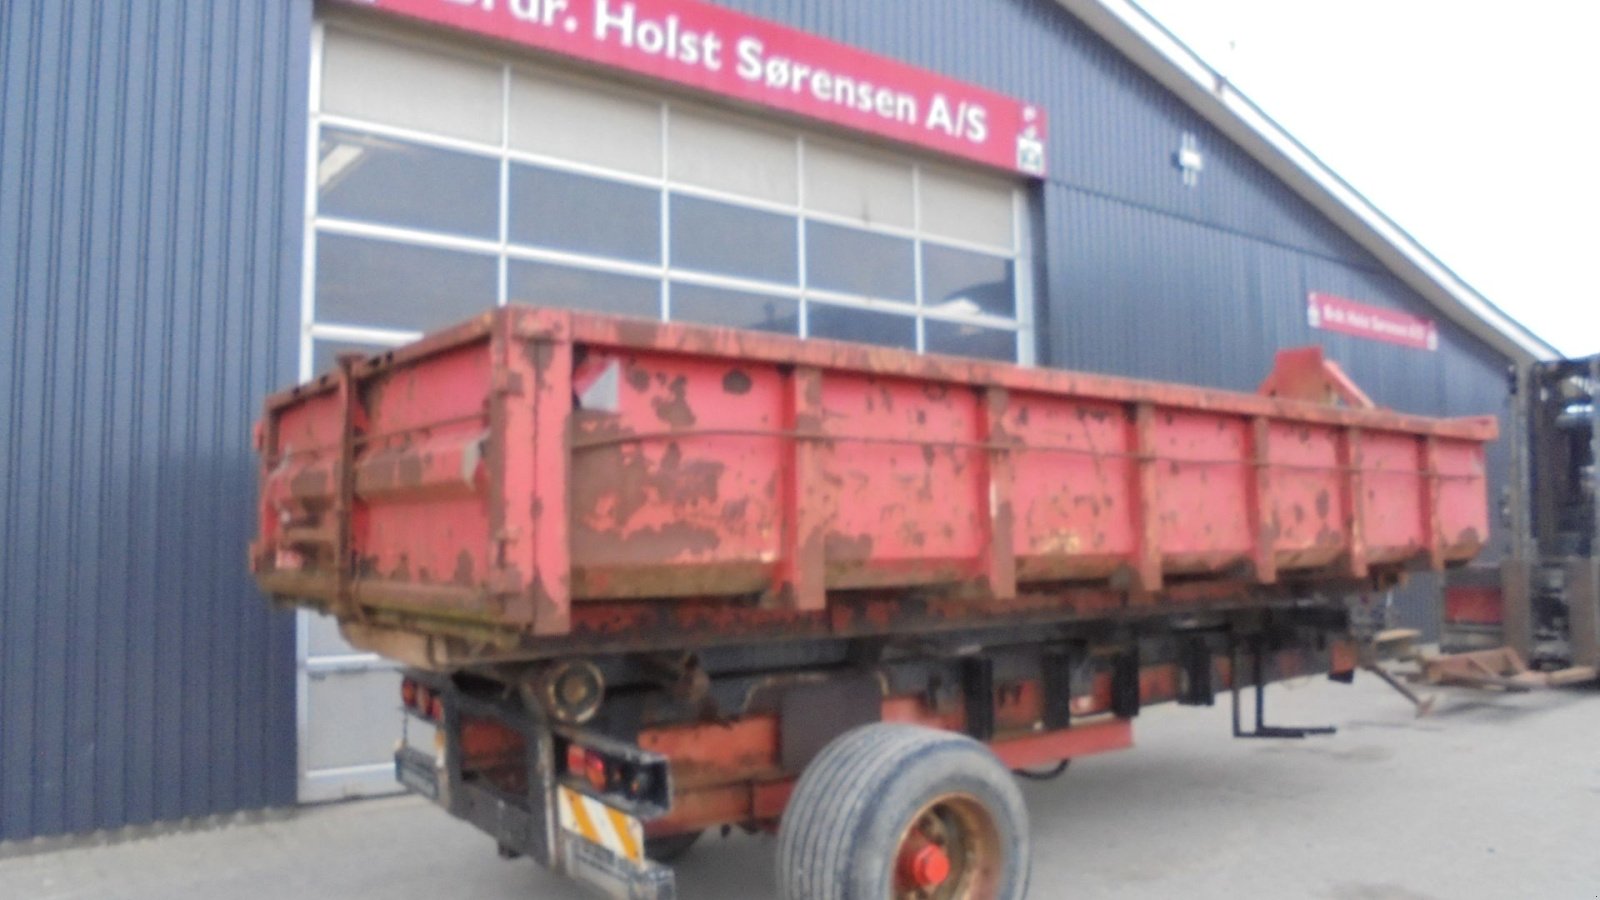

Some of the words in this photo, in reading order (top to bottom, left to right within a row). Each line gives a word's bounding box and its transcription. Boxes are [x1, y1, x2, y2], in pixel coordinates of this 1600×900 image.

[448, 0, 578, 33] dr.
[594, 0, 722, 71] Holst
[736, 36, 918, 124] Sørensen
[925, 92, 988, 143] A/S
